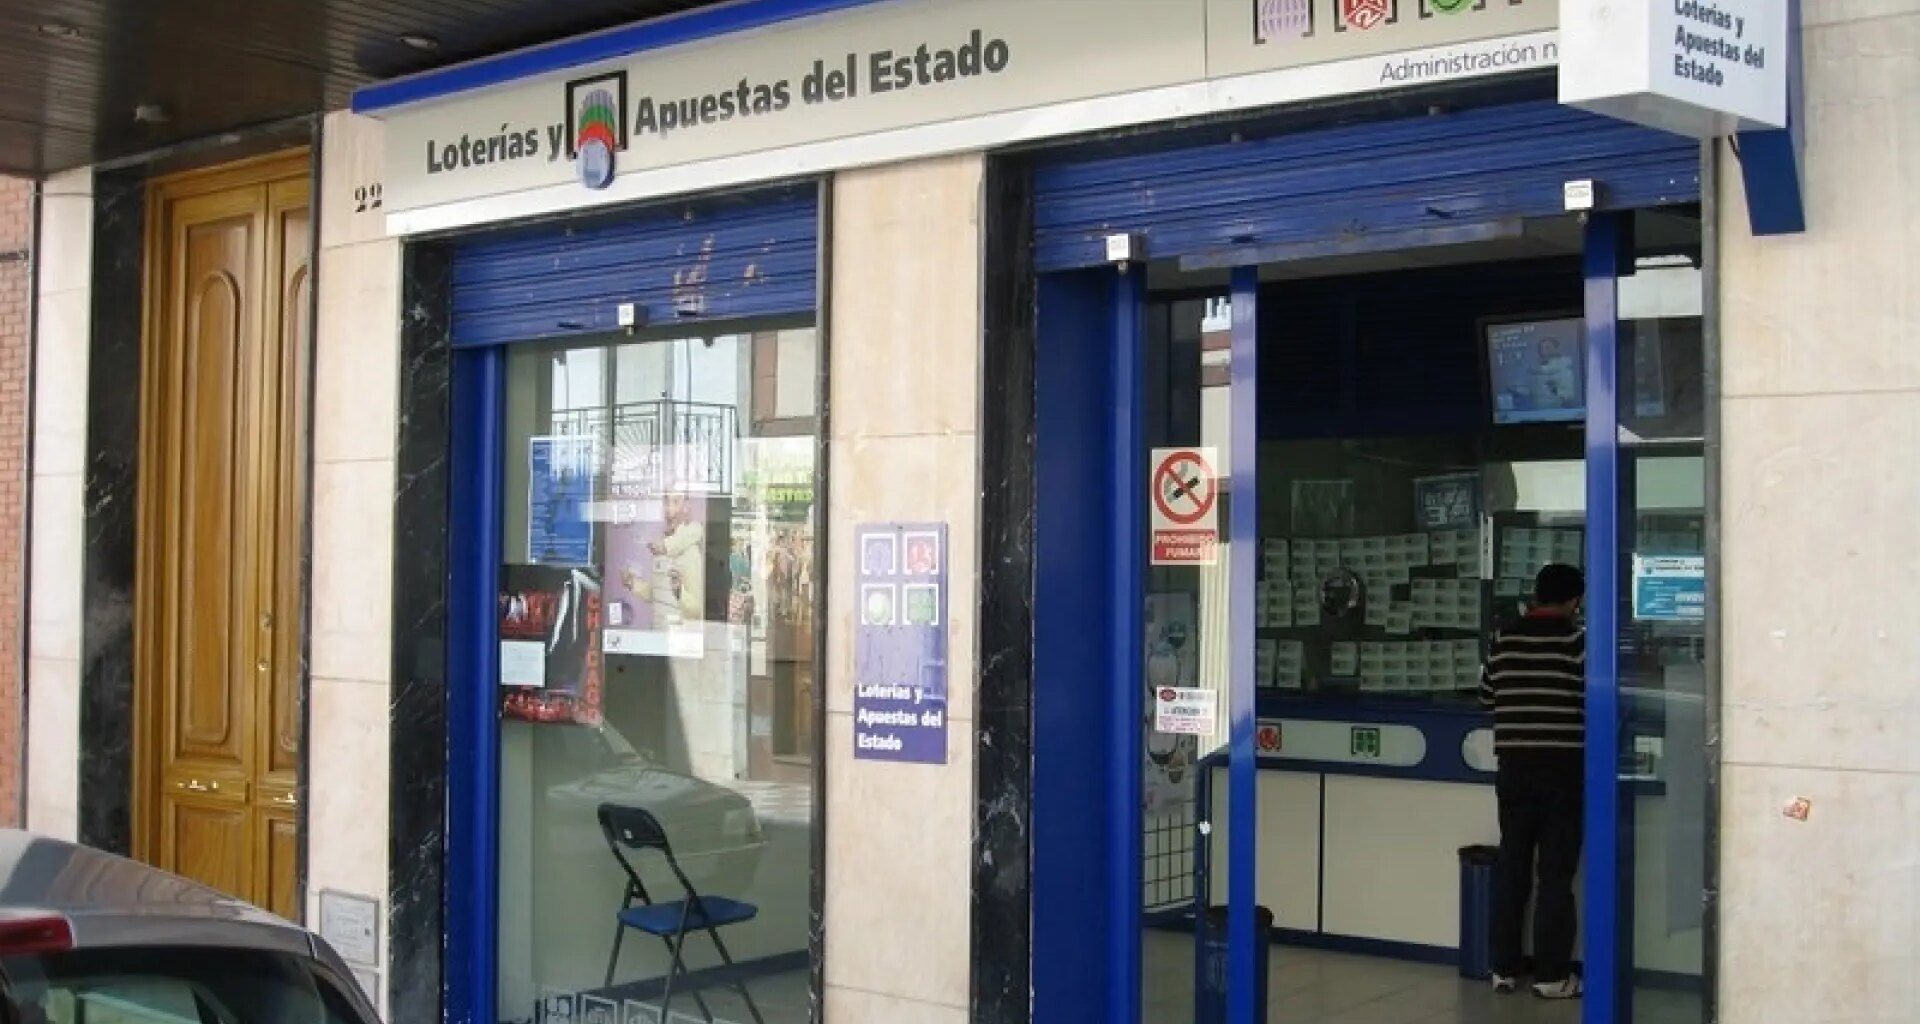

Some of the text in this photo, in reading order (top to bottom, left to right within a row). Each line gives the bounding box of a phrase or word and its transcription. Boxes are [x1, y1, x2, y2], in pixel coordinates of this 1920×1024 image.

[1735, 17, 1744, 39] y
[1674, 24, 1765, 69] Apuestas del
[1380, 42, 1537, 84] Administración
[1674, 53, 1724, 88] Estado
[427, 29, 1009, 175] Loterías y Apuestas del Estado
[1165, 547, 1211, 558] FUMA
[858, 682, 922, 705] Loterías y
[857, 707, 943, 729] Apuestas del
[858, 732, 903, 752] Estado
